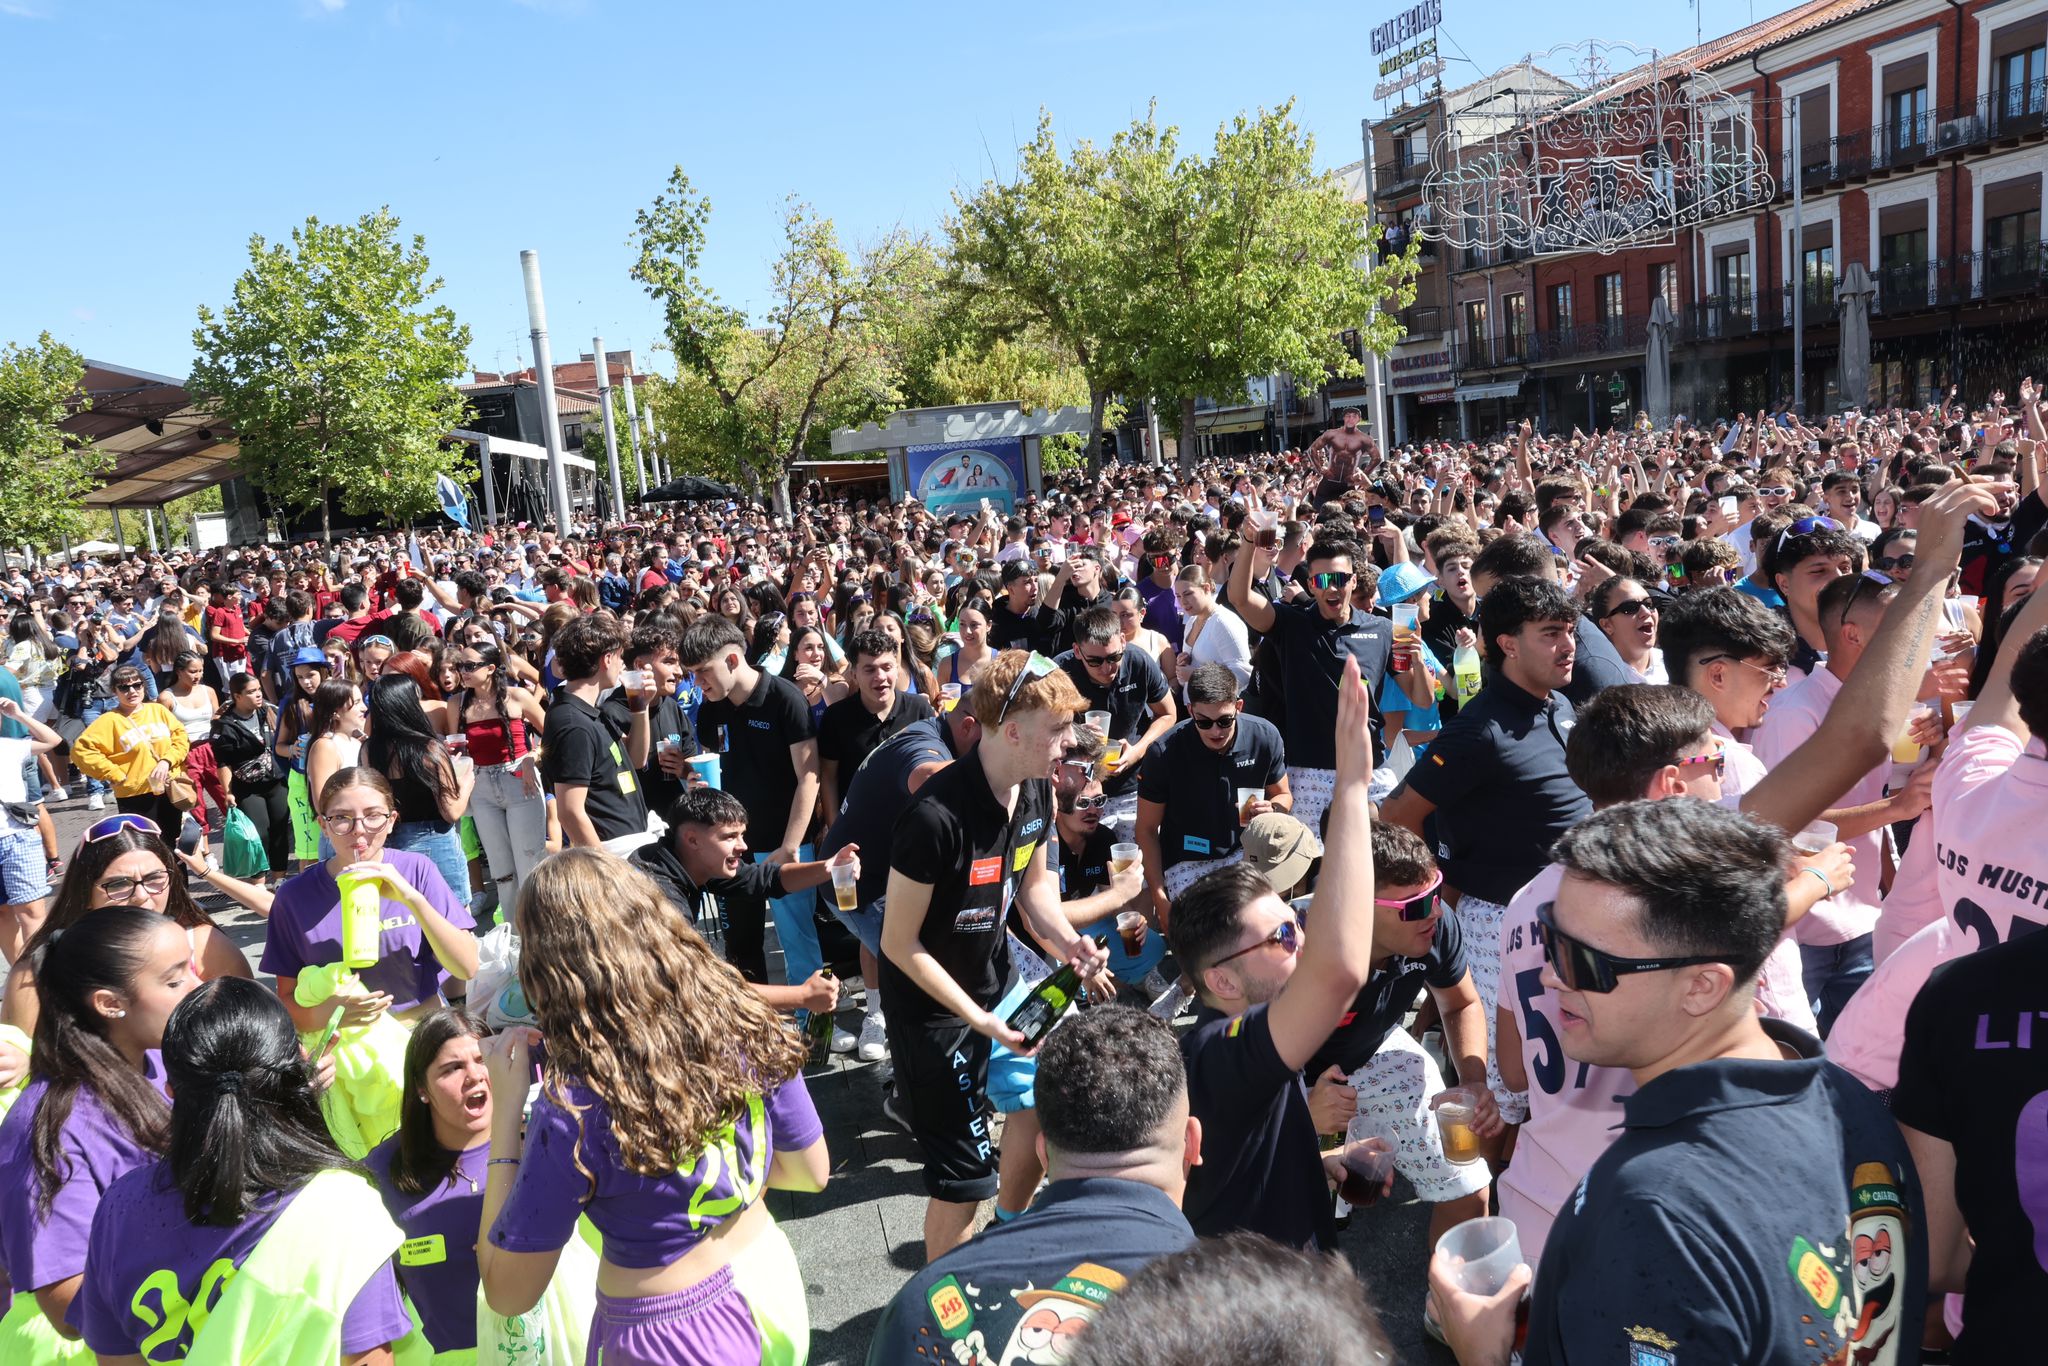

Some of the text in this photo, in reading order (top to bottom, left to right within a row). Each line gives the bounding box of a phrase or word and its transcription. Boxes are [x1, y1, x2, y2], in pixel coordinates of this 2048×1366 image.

[1370, 0, 1442, 56] GALERIAS
[1379, 38, 1437, 77] MUEBLES
[1020, 818, 1043, 837] ASIER
[1937, 842, 1969, 877] LOS
[953, 1050, 991, 1161] ASIER
